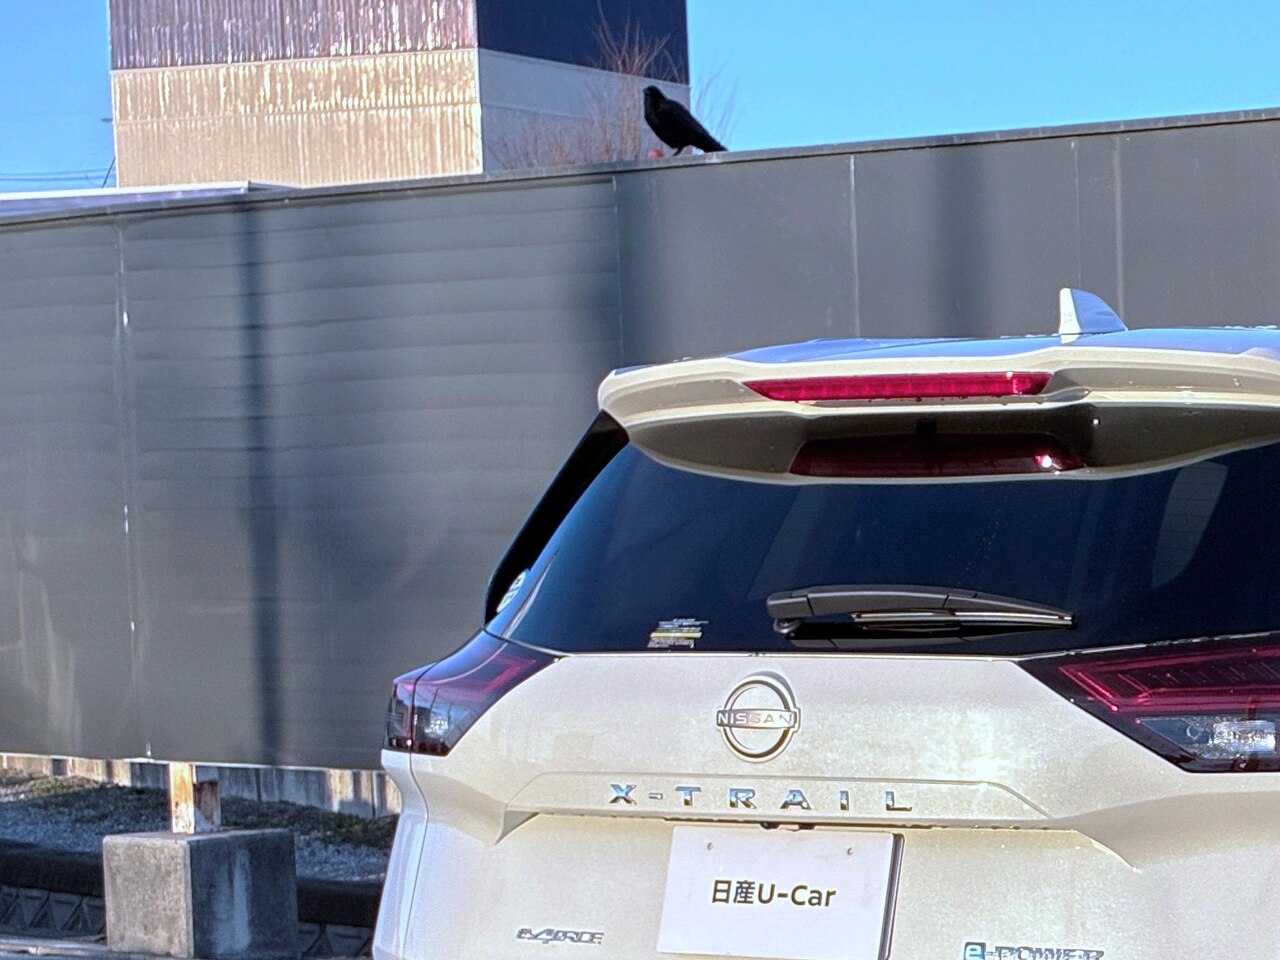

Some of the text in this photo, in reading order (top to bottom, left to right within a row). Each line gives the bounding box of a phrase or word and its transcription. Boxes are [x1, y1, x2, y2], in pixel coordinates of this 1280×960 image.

[717, 711, 794, 727] NISSAN
[609, 782, 913, 812] X-TRAIL
[711, 878, 837, 908] 日産U-Car
